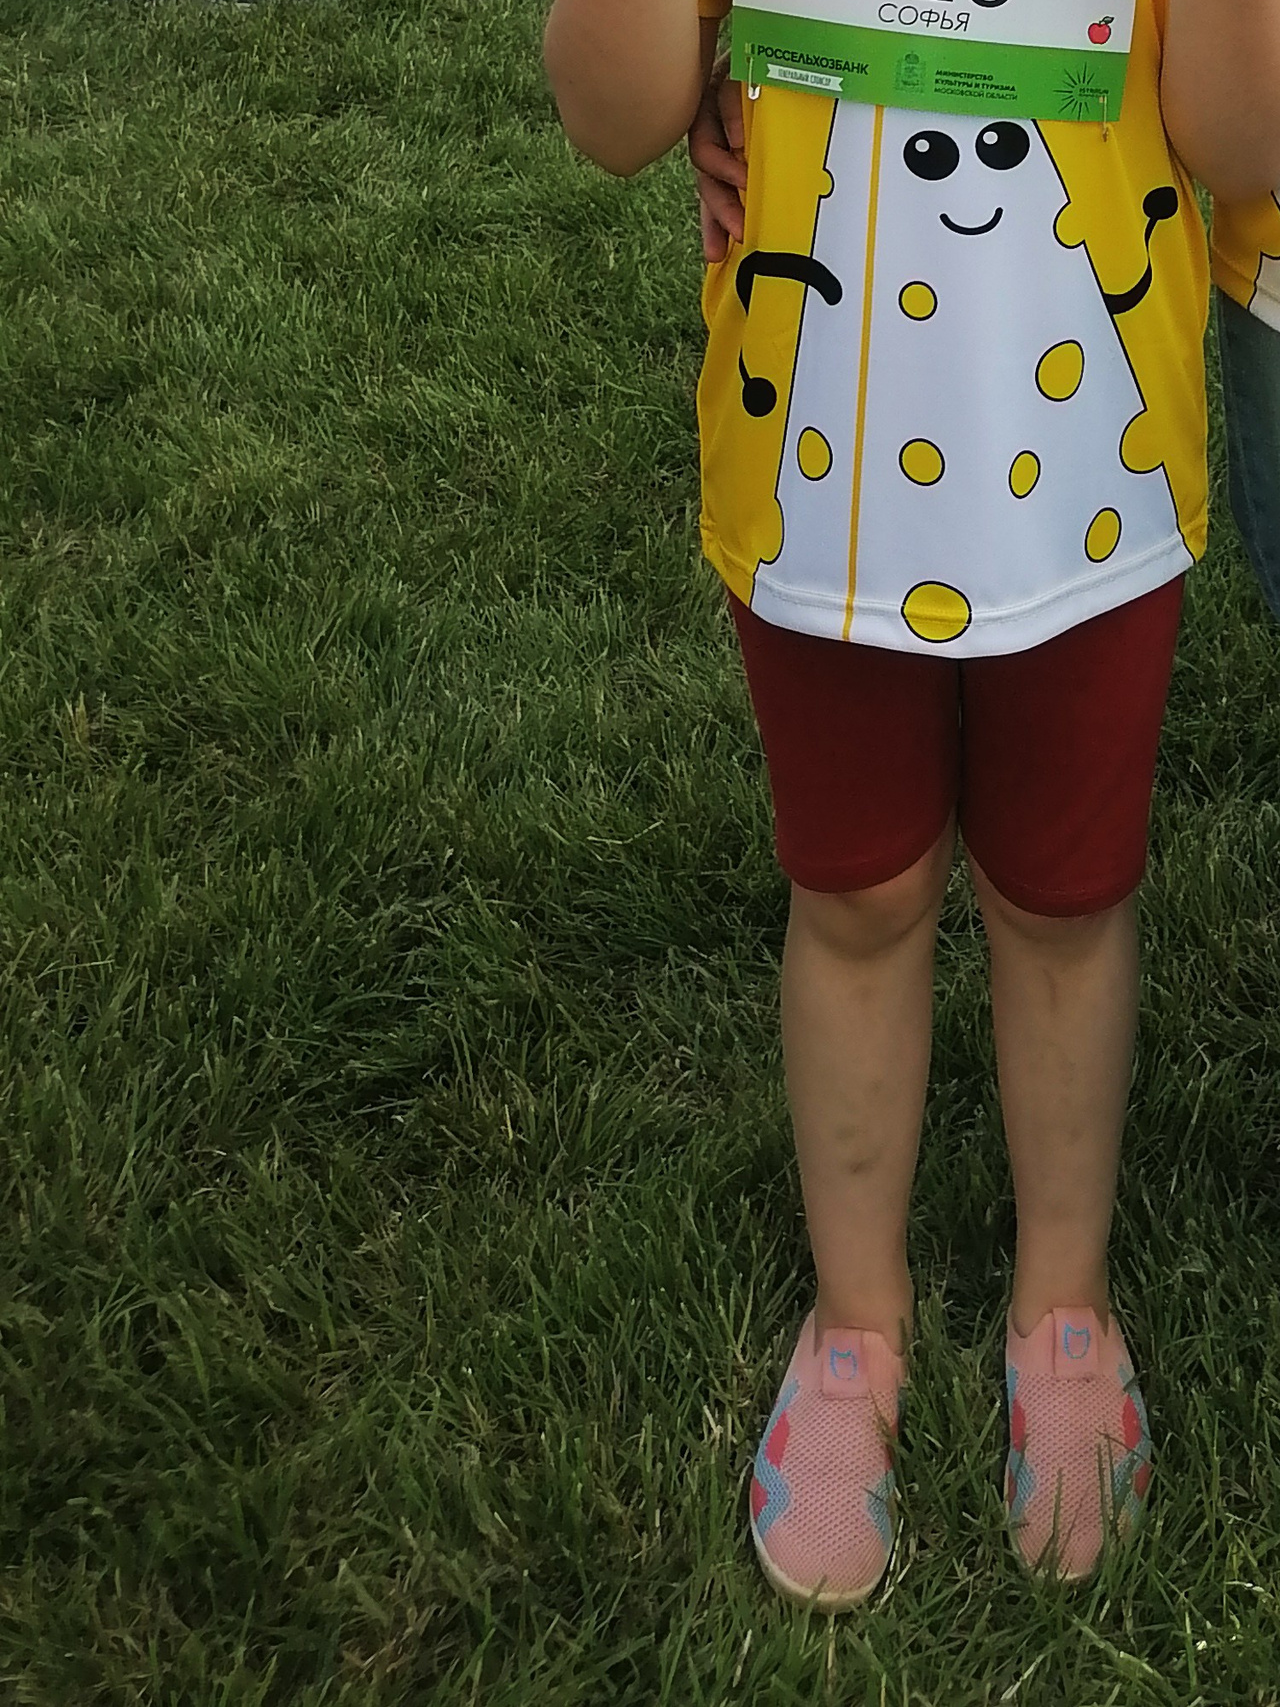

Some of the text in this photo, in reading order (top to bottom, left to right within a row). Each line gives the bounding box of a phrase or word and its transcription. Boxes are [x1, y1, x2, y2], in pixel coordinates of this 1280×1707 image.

[878, 2, 971, 32] СОФЬЯ
[757, 44, 869, 75] РОССЕЛЬХОЗБАНК
[935, 69, 994, 82] МИНИСТЕРСТВО
[934, 87, 985, 99] МОСКОВСКОЙ
